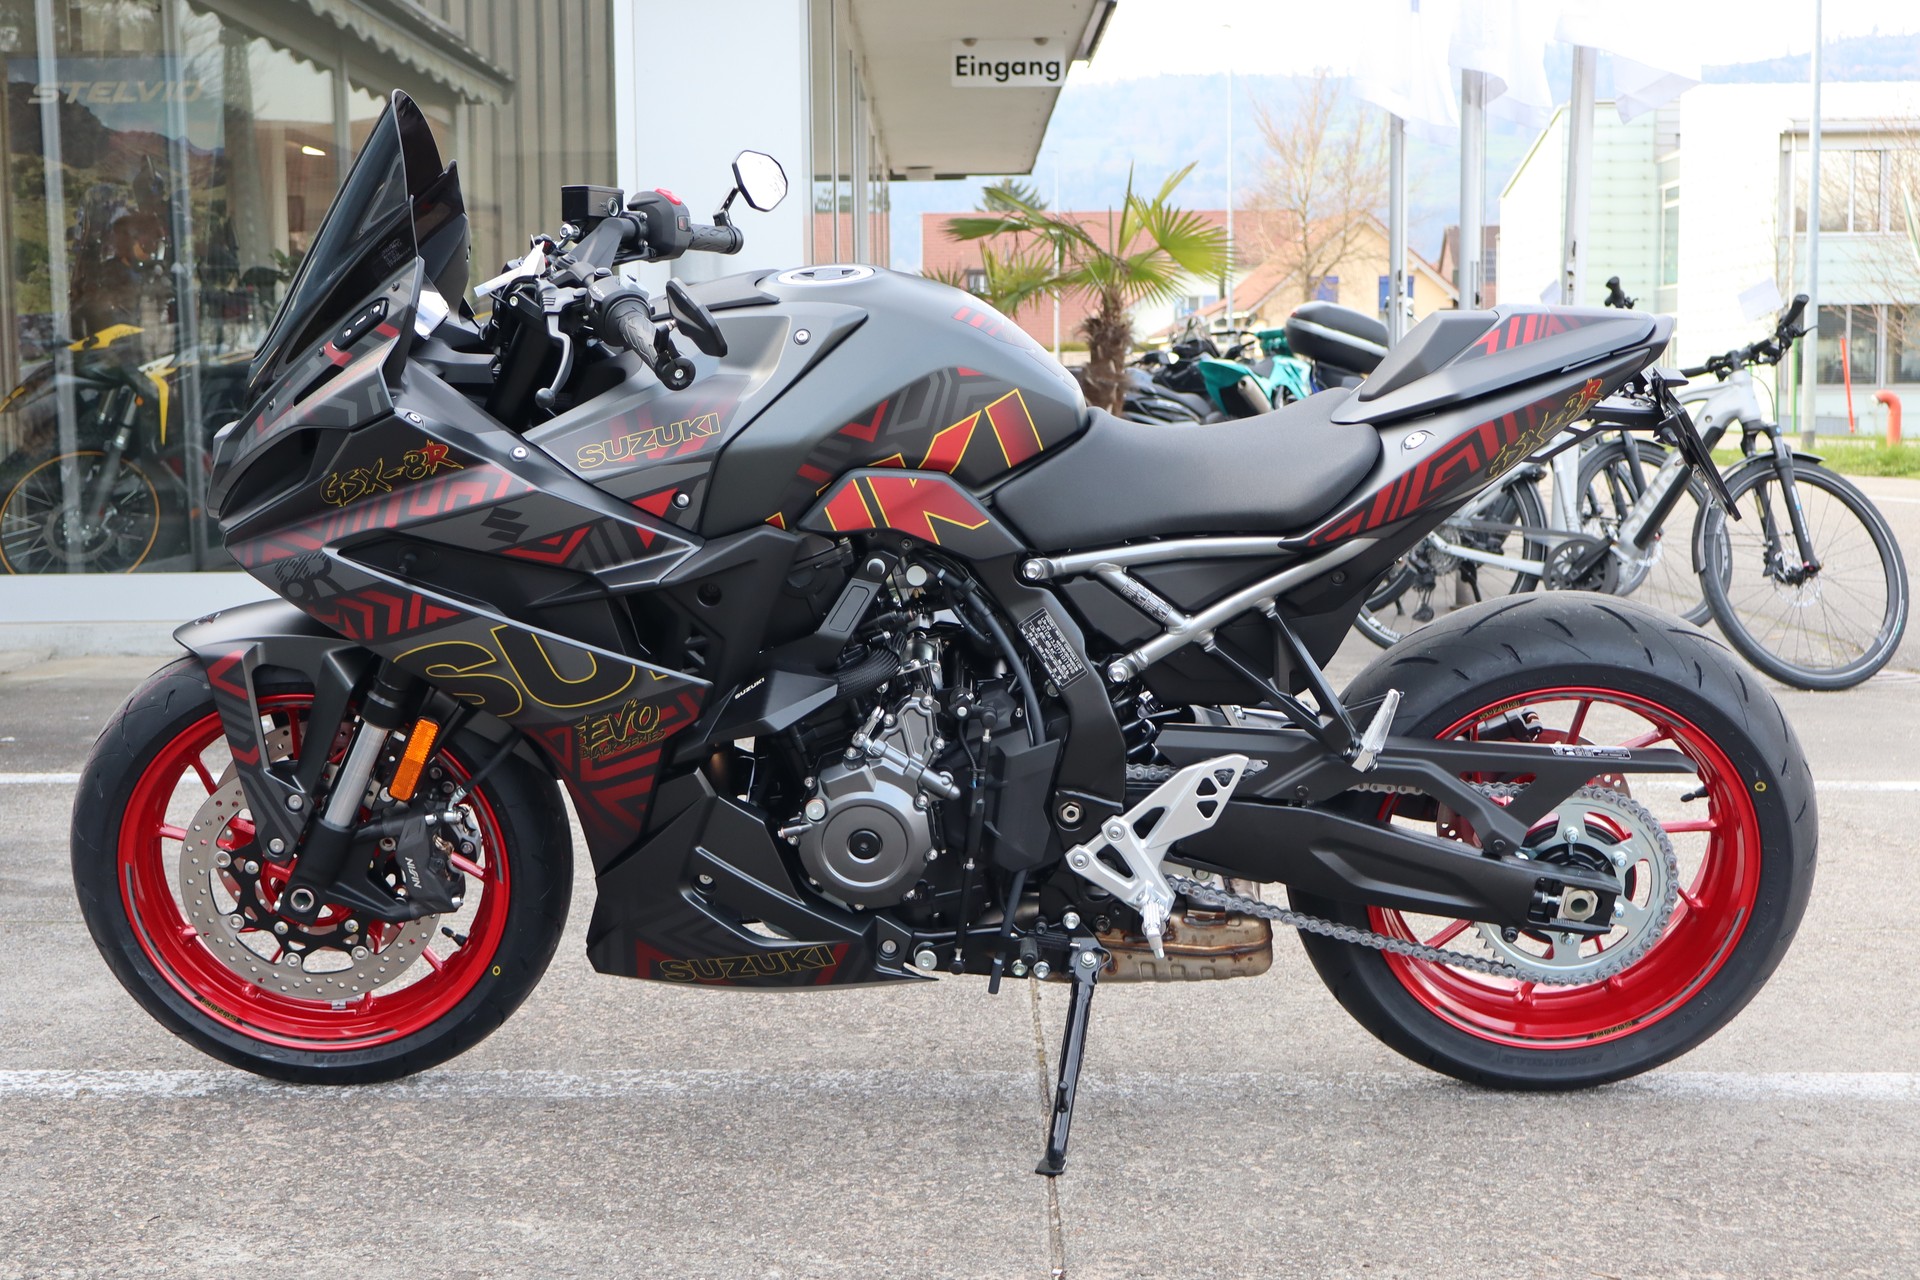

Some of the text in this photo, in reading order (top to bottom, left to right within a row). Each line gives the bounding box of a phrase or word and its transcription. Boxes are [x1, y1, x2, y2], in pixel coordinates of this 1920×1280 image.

[956, 55, 1060, 82] Eingang
[28, 80, 204, 104] STELVIO
[577, 412, 721, 469] SUZUKI
[320, 439, 465, 507] GSX-8R
[393, 624, 668, 717] SU
[734, 677, 765, 700] SUZUKI
[574, 698, 660, 751] EVO
[619, 729, 667, 752] SERIES
[660, 945, 836, 982] SUZUKI
